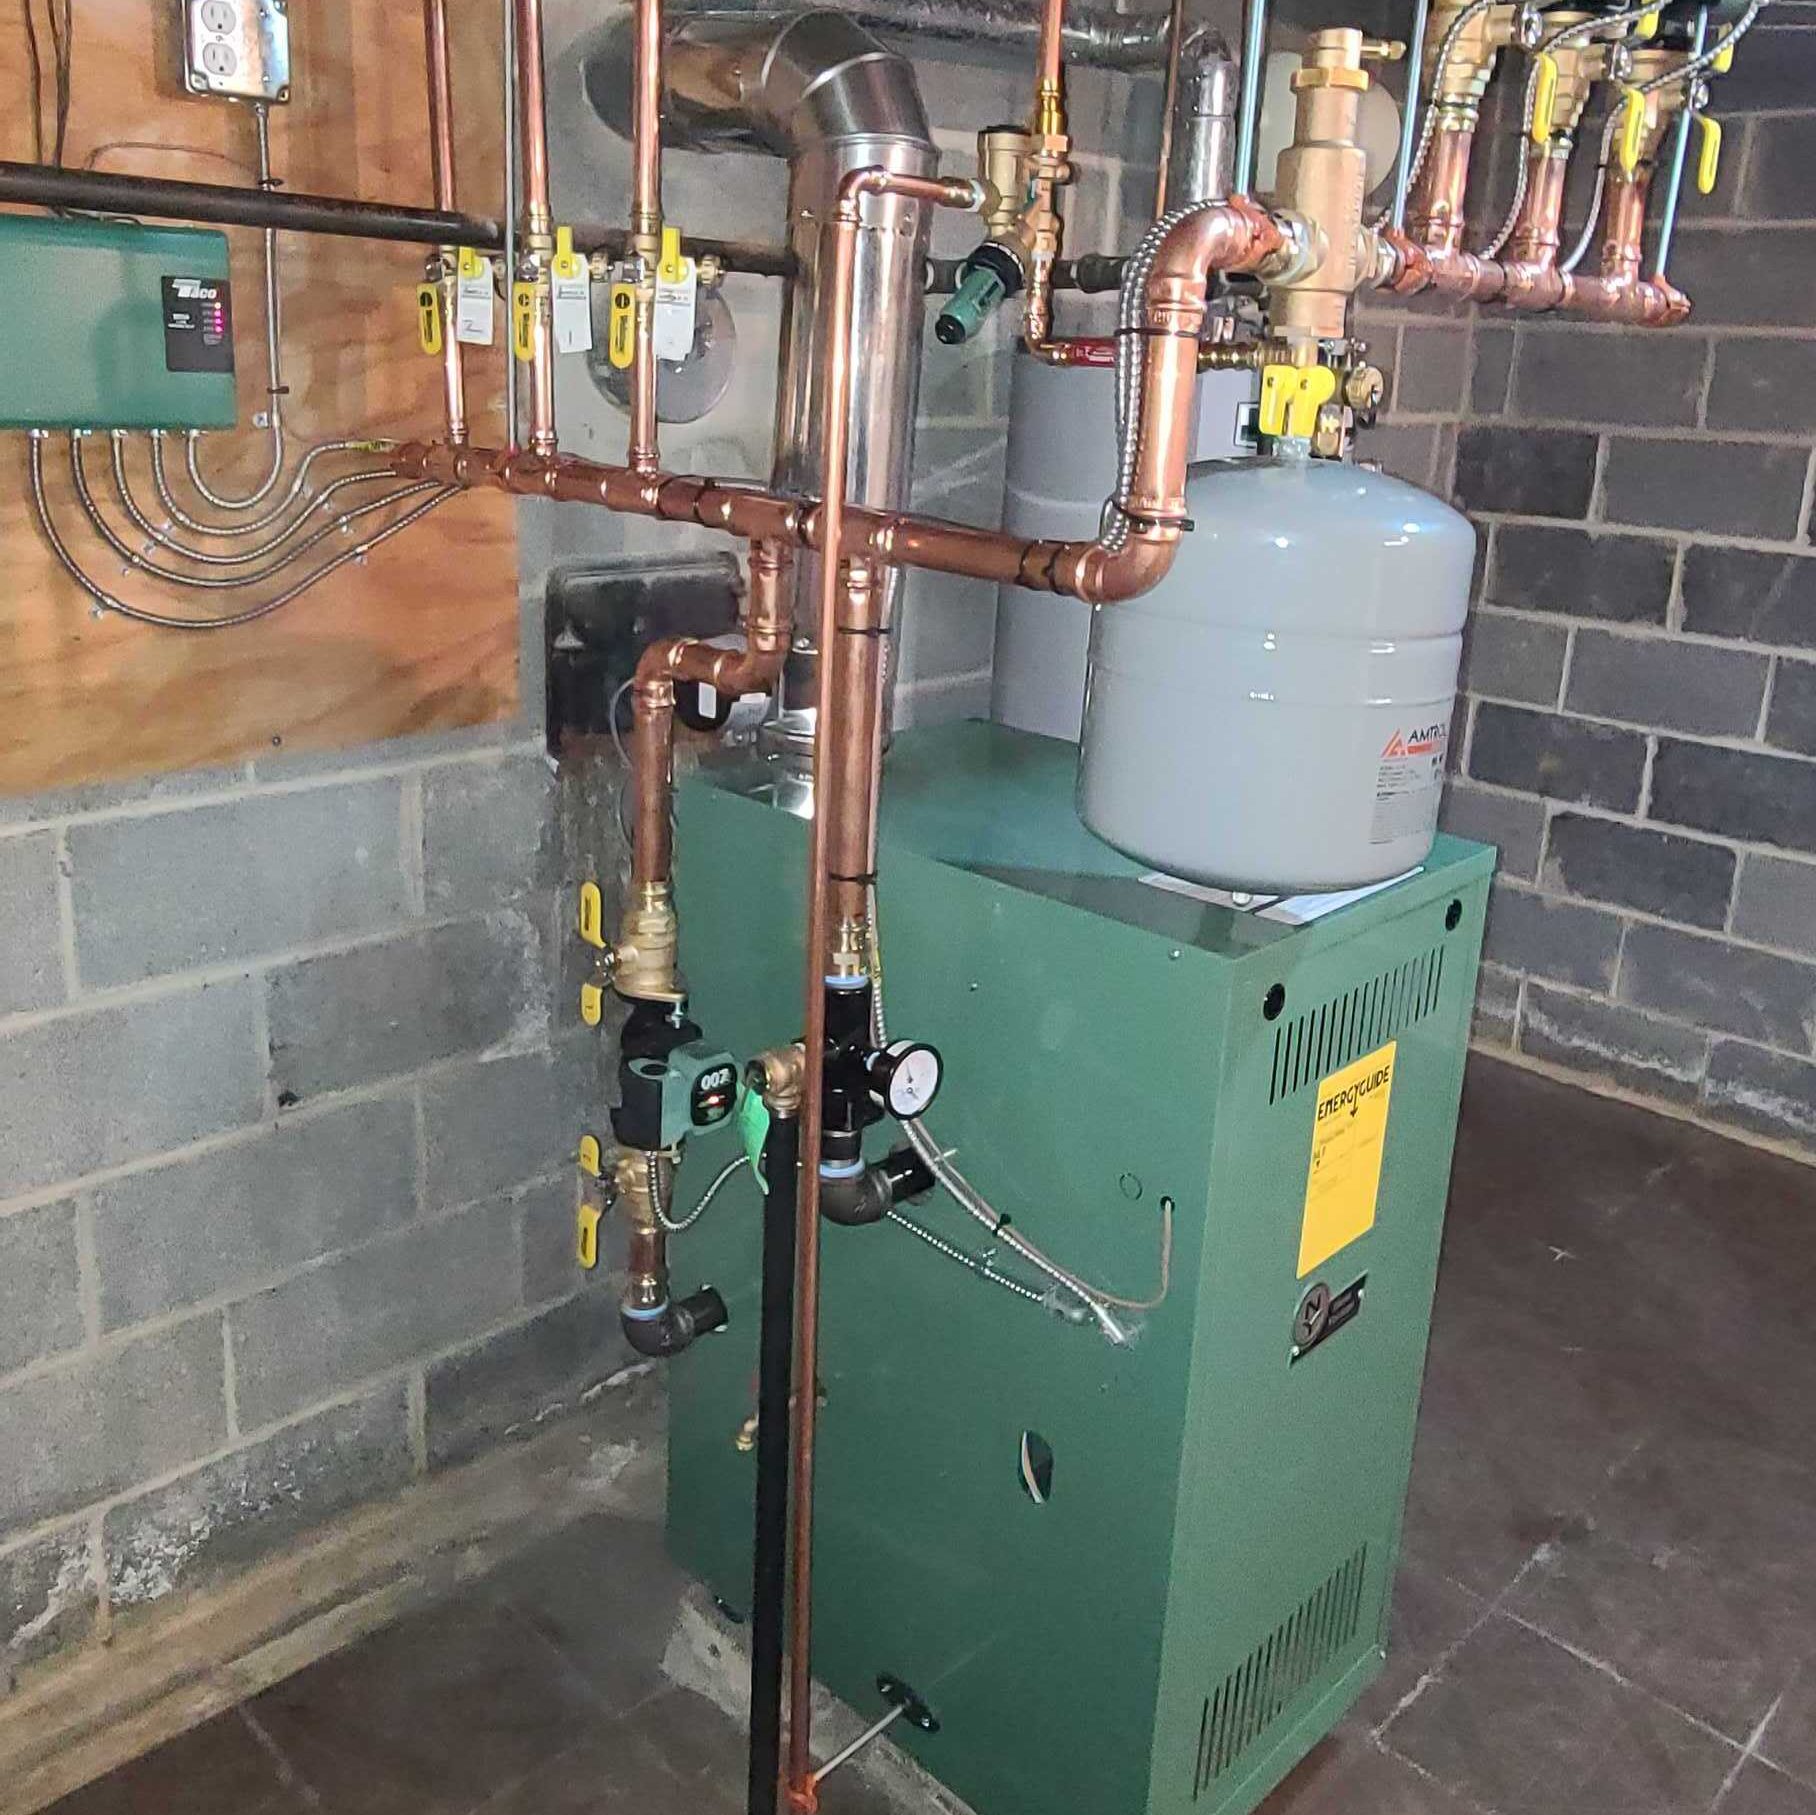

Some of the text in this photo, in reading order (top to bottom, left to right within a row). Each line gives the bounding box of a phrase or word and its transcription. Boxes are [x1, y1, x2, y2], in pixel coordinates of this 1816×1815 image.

[172, 278, 217, 299] Taco
[700, 1067, 730, 1091] 007
[1317, 1064, 1391, 1121] ENERGYGUIDE
